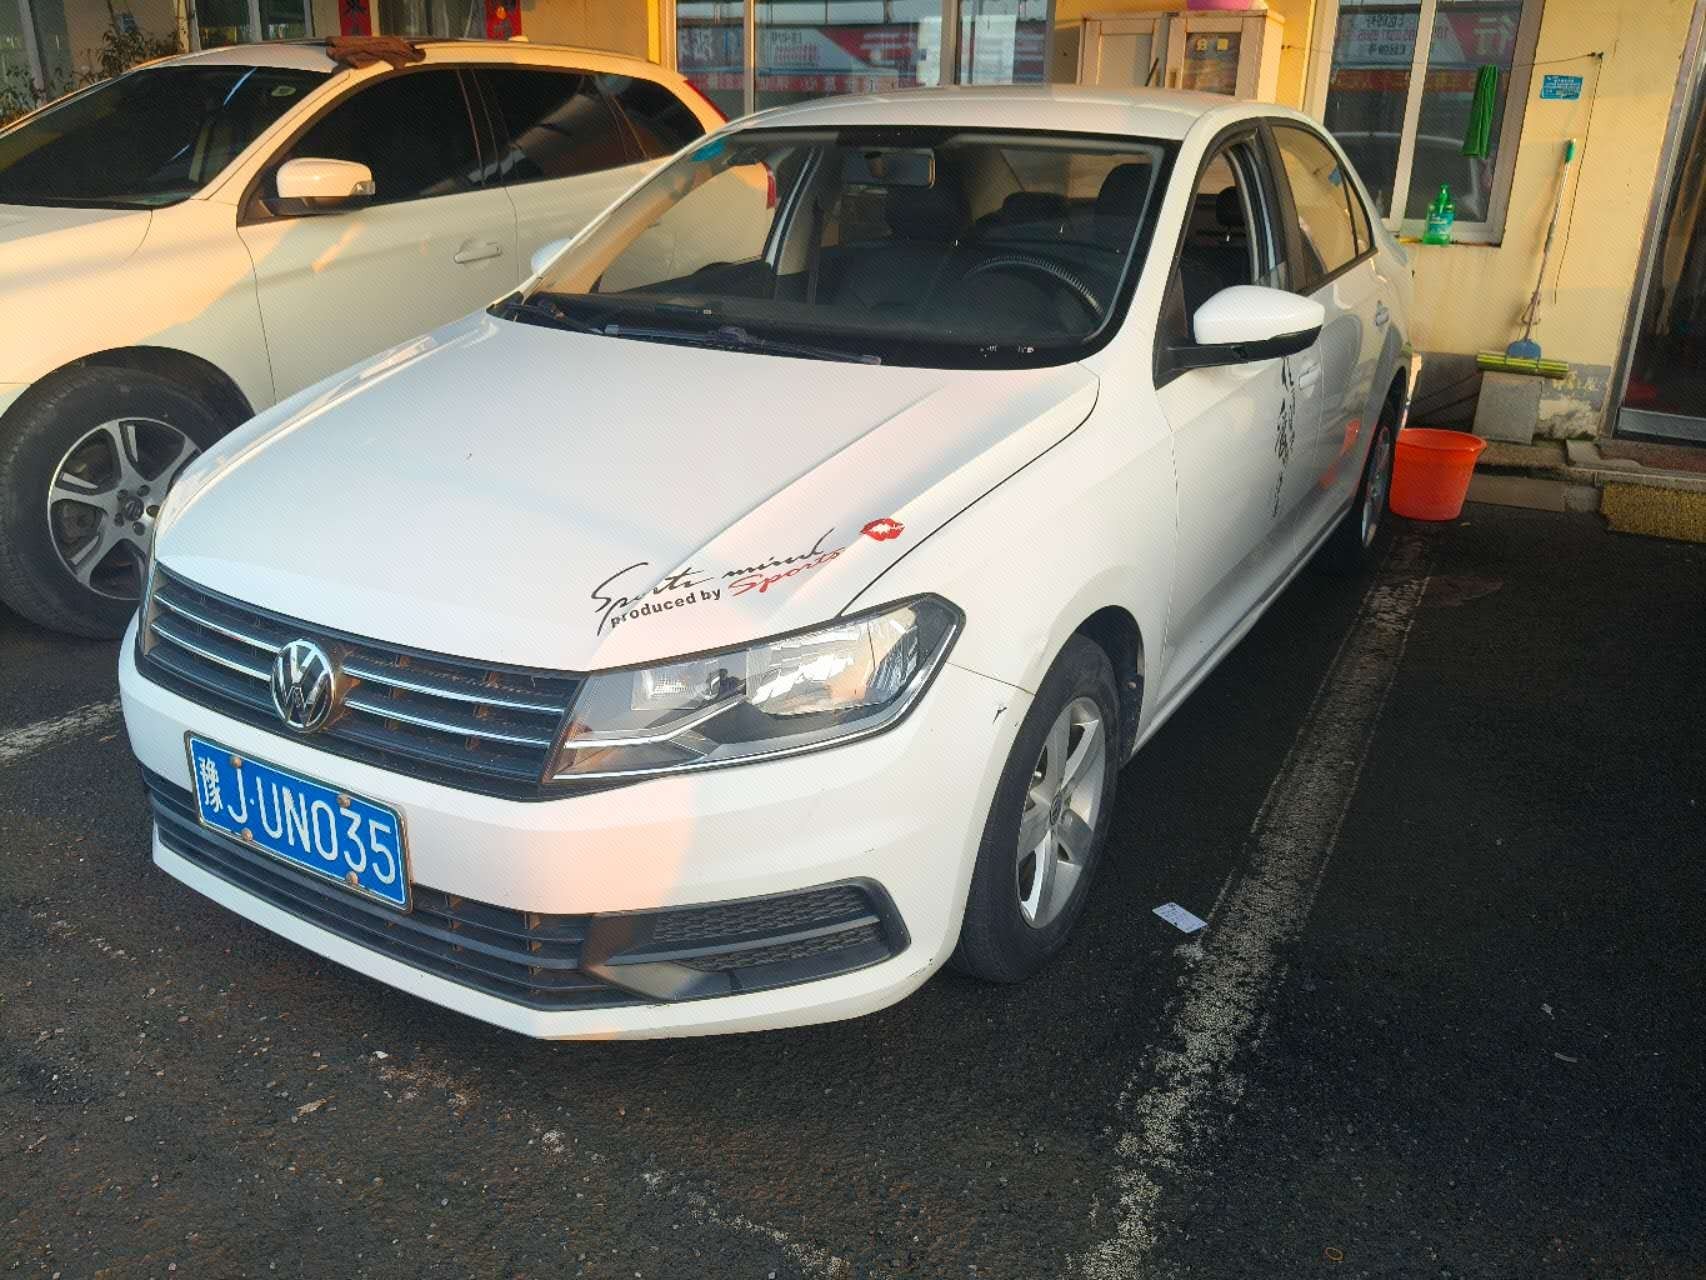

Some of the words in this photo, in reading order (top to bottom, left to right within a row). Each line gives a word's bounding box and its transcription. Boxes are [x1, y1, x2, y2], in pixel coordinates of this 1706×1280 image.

[611, 592, 696, 628] produced
[700, 588, 720, 602] by
[728, 547, 846, 596] Sports
